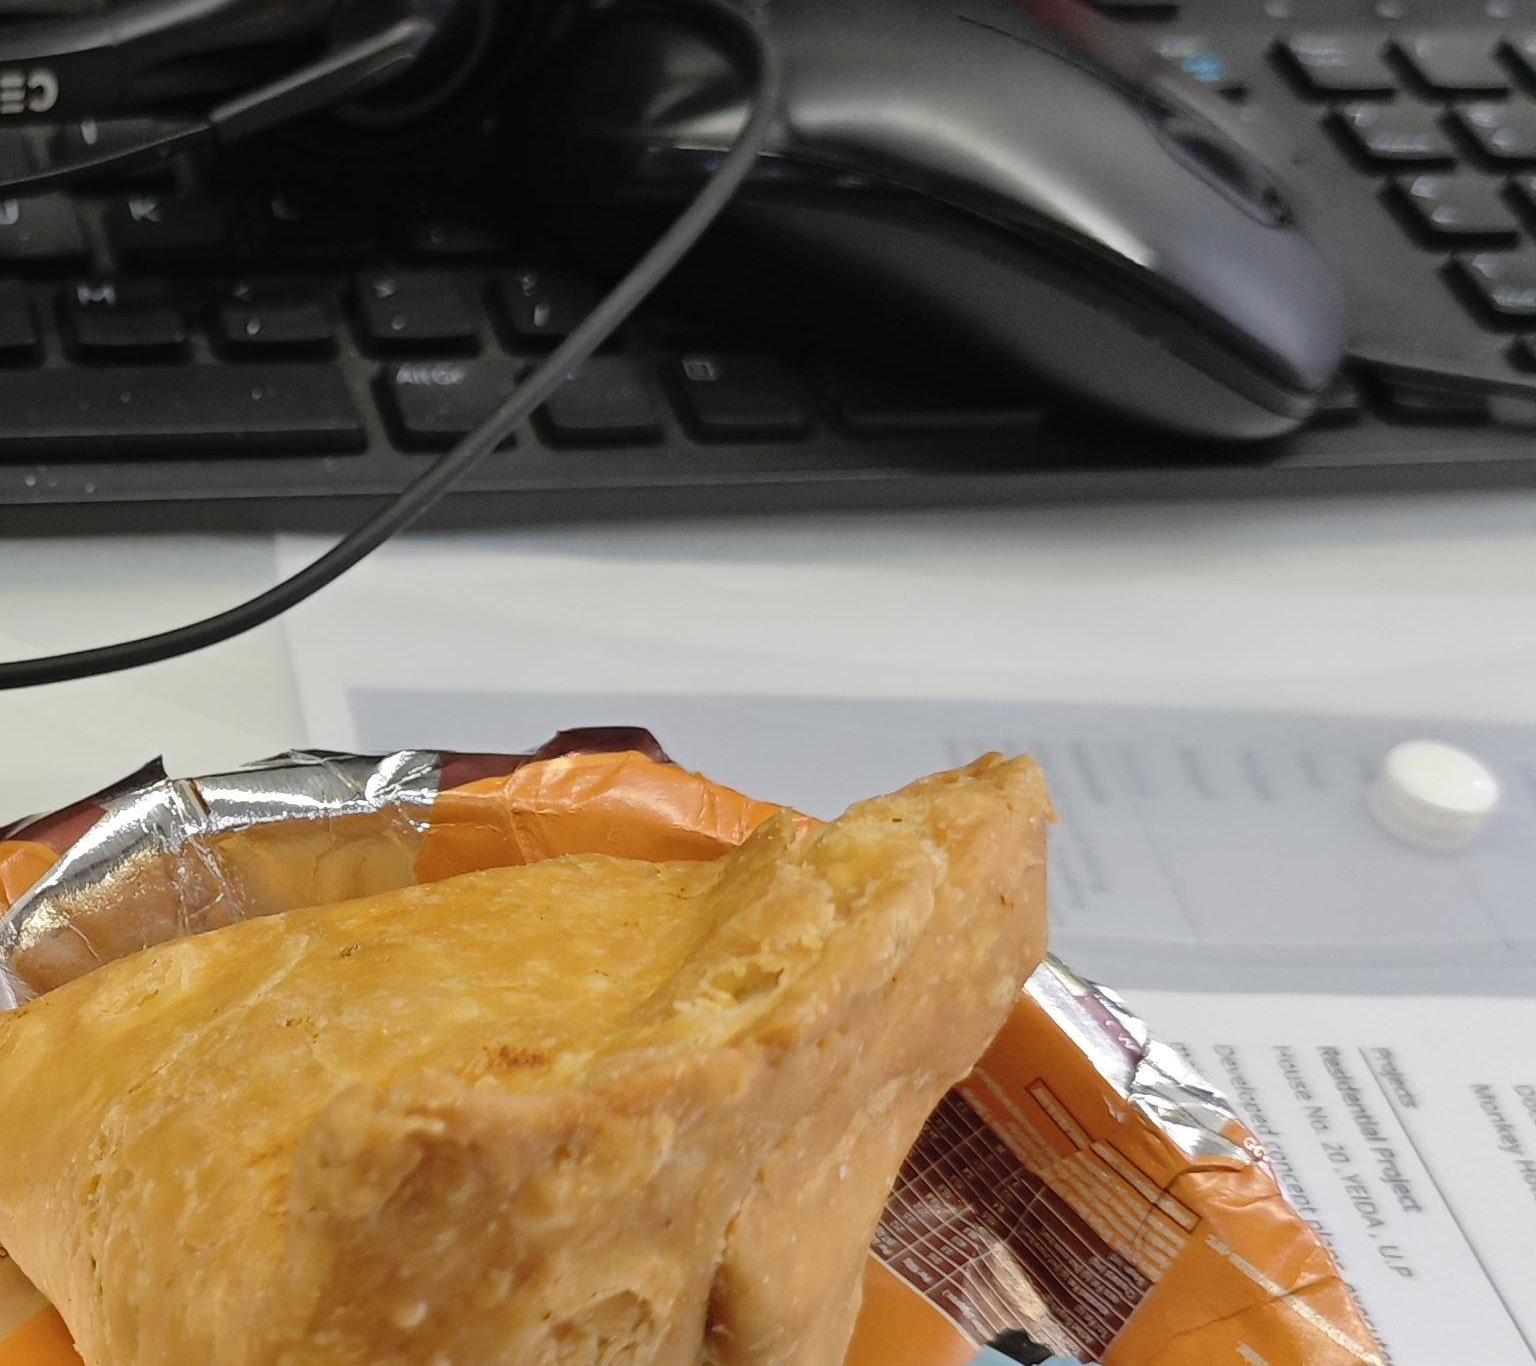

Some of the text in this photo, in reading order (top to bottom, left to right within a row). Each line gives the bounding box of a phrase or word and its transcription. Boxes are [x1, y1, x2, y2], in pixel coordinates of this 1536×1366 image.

[1269, 1048, 1312, 1101] House
[1367, 1045, 1421, 1110] Projects
[1315, 1046, 1424, 1217] Residential Project
